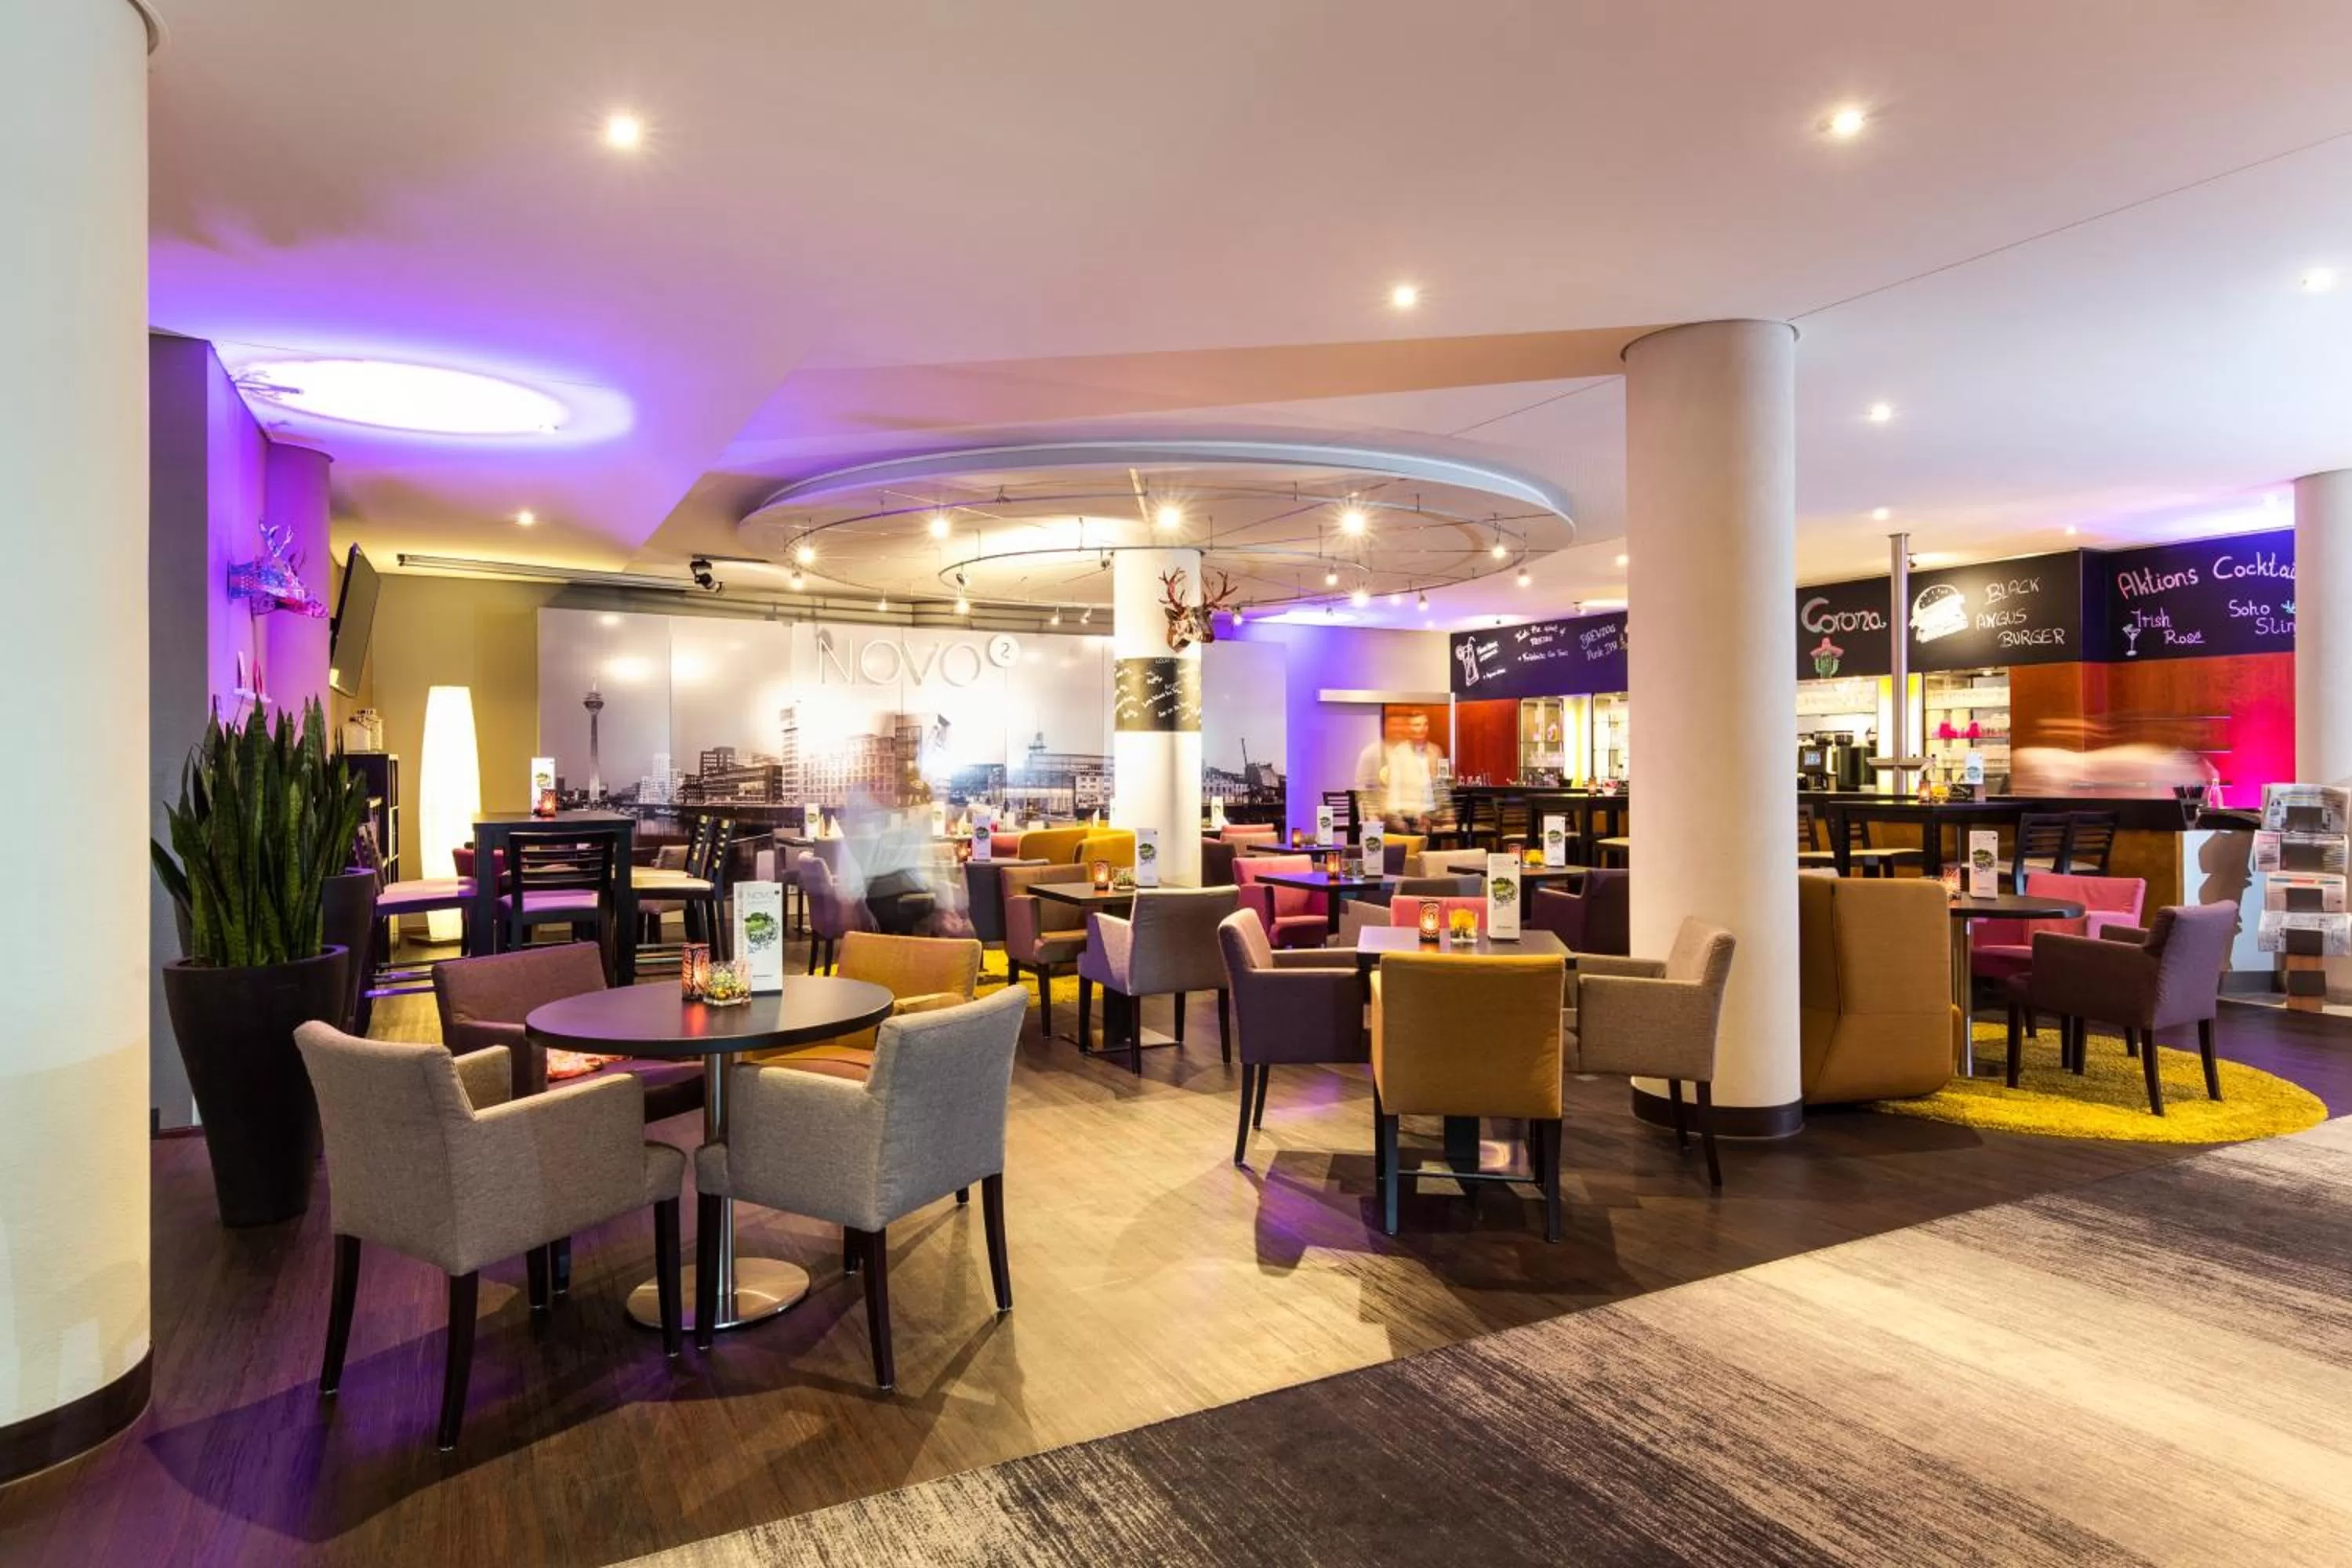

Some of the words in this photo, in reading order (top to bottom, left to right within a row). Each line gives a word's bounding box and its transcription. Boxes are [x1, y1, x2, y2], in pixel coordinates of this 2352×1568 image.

[1984, 576, 2040, 605] BLACK
[2118, 567, 2198, 600] Aktions
[1801, 597, 1887, 633] Corona
[1976, 608, 2027, 630] ANGUS
[2130, 607, 2172, 628] Irish
[2229, 599, 2270, 617] Soho
[1998, 627, 2066, 648] BURGER
[818, 636, 982, 688] NOVO
